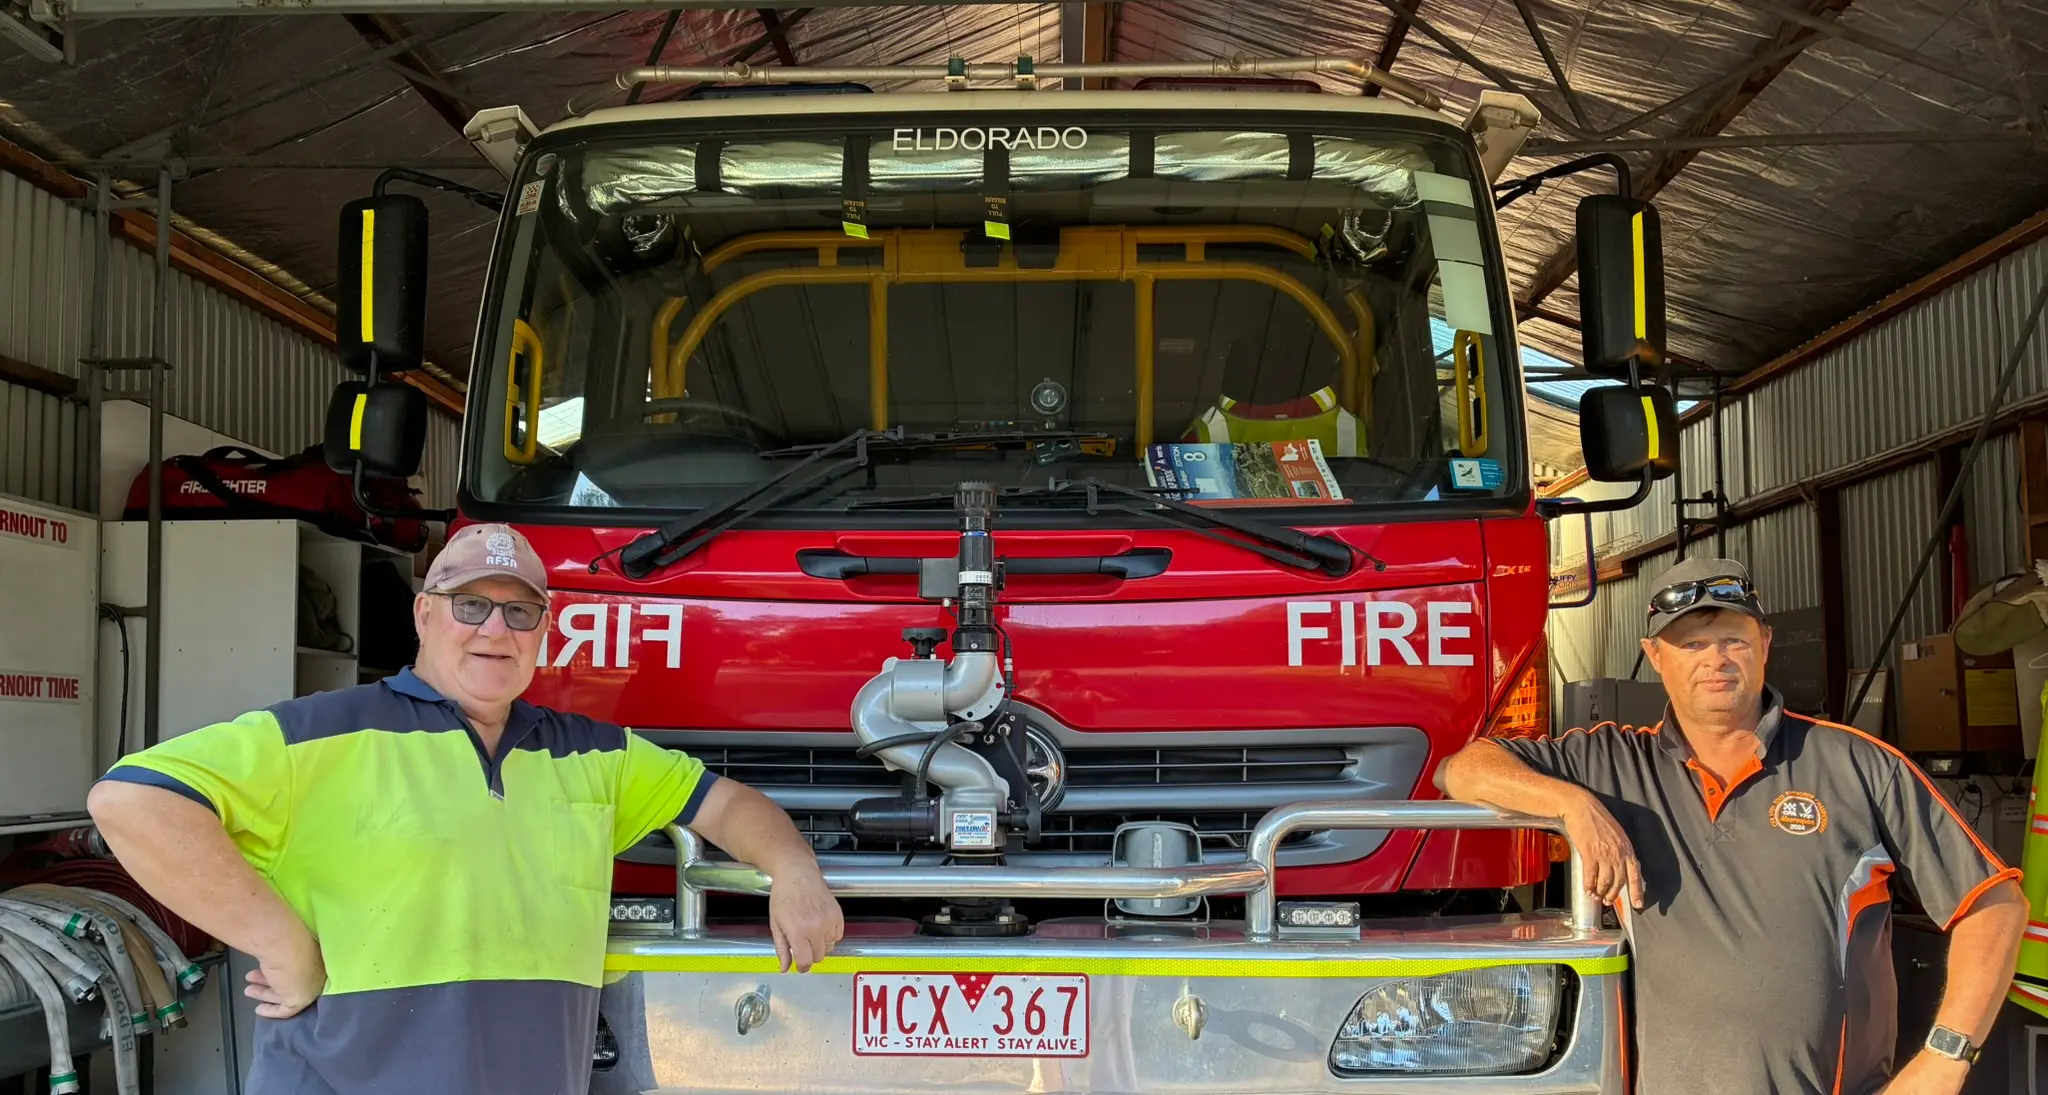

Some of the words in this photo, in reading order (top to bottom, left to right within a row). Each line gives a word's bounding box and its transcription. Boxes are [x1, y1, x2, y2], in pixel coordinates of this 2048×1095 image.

[893, 127, 1087, 151] ELDORADO
[1184, 451, 1206, 462] 8
[50, 520, 67, 543] TO
[1287, 601, 1474, 667] FIRE
[46, 677, 79, 699] TIME
[1789, 823, 1806, 831] 2024
[862, 985, 950, 1035] MCX
[992, 986, 1078, 1036] 367
[864, 1036, 888, 1048] VIC
[905, 1036, 941, 1049] STAY
[944, 1037, 989, 1049] ALERT
[997, 1038, 1031, 1050] STAY
[1036, 1038, 1078, 1050] ALIVE
